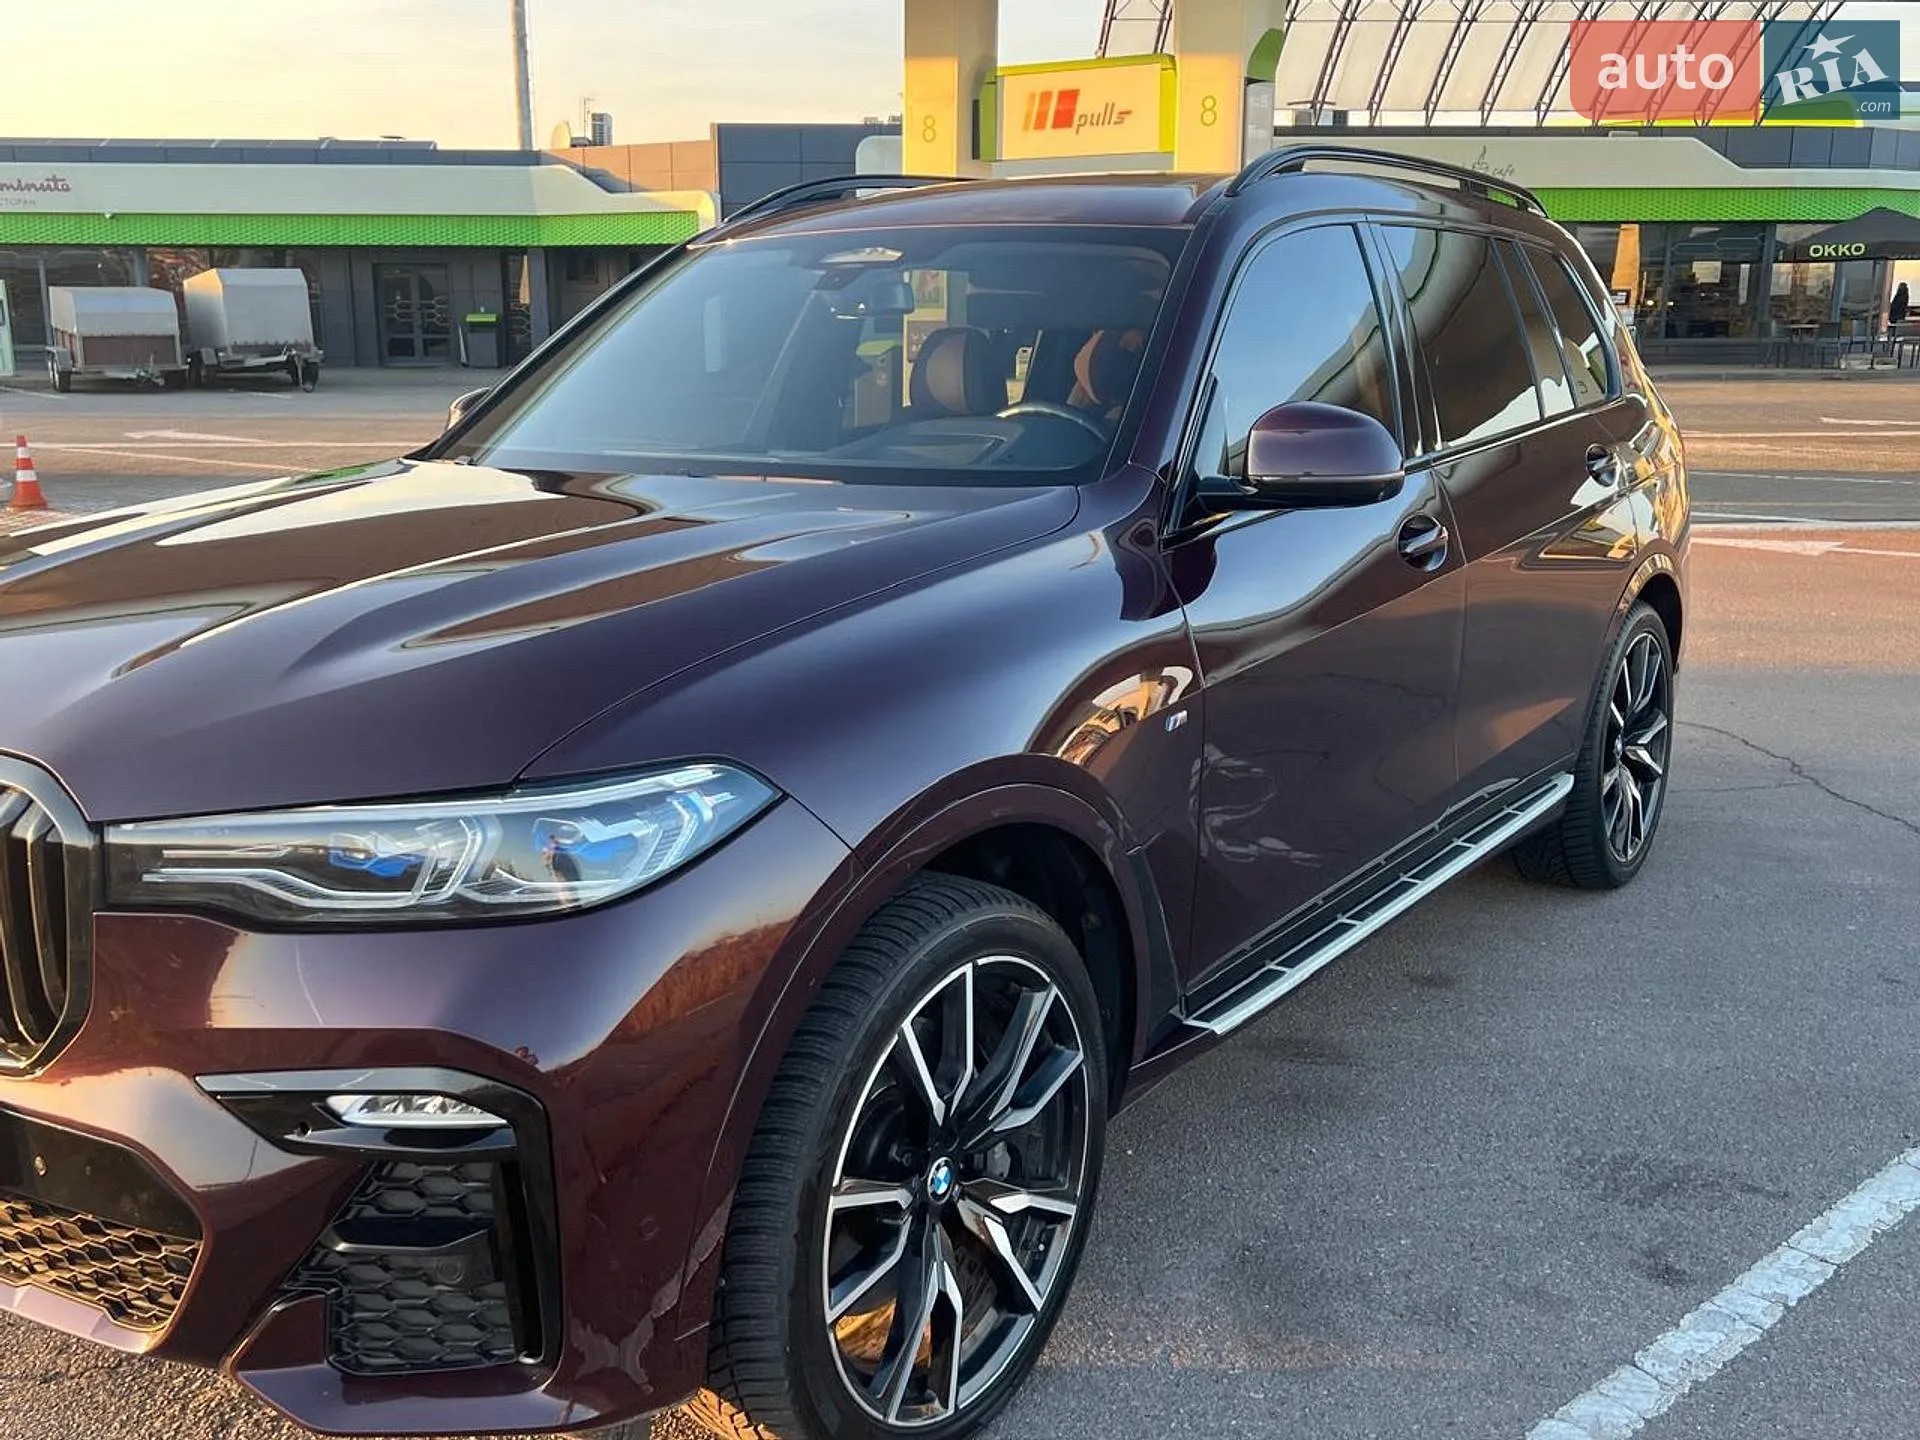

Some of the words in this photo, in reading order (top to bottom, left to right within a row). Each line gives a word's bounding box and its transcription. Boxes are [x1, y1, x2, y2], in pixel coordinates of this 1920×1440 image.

[1075, 102, 1132, 134] pulls
[1200, 94, 1218, 127] 8
[922, 114, 937, 143] 8
[1808, 242, 1866, 258] OKKO
